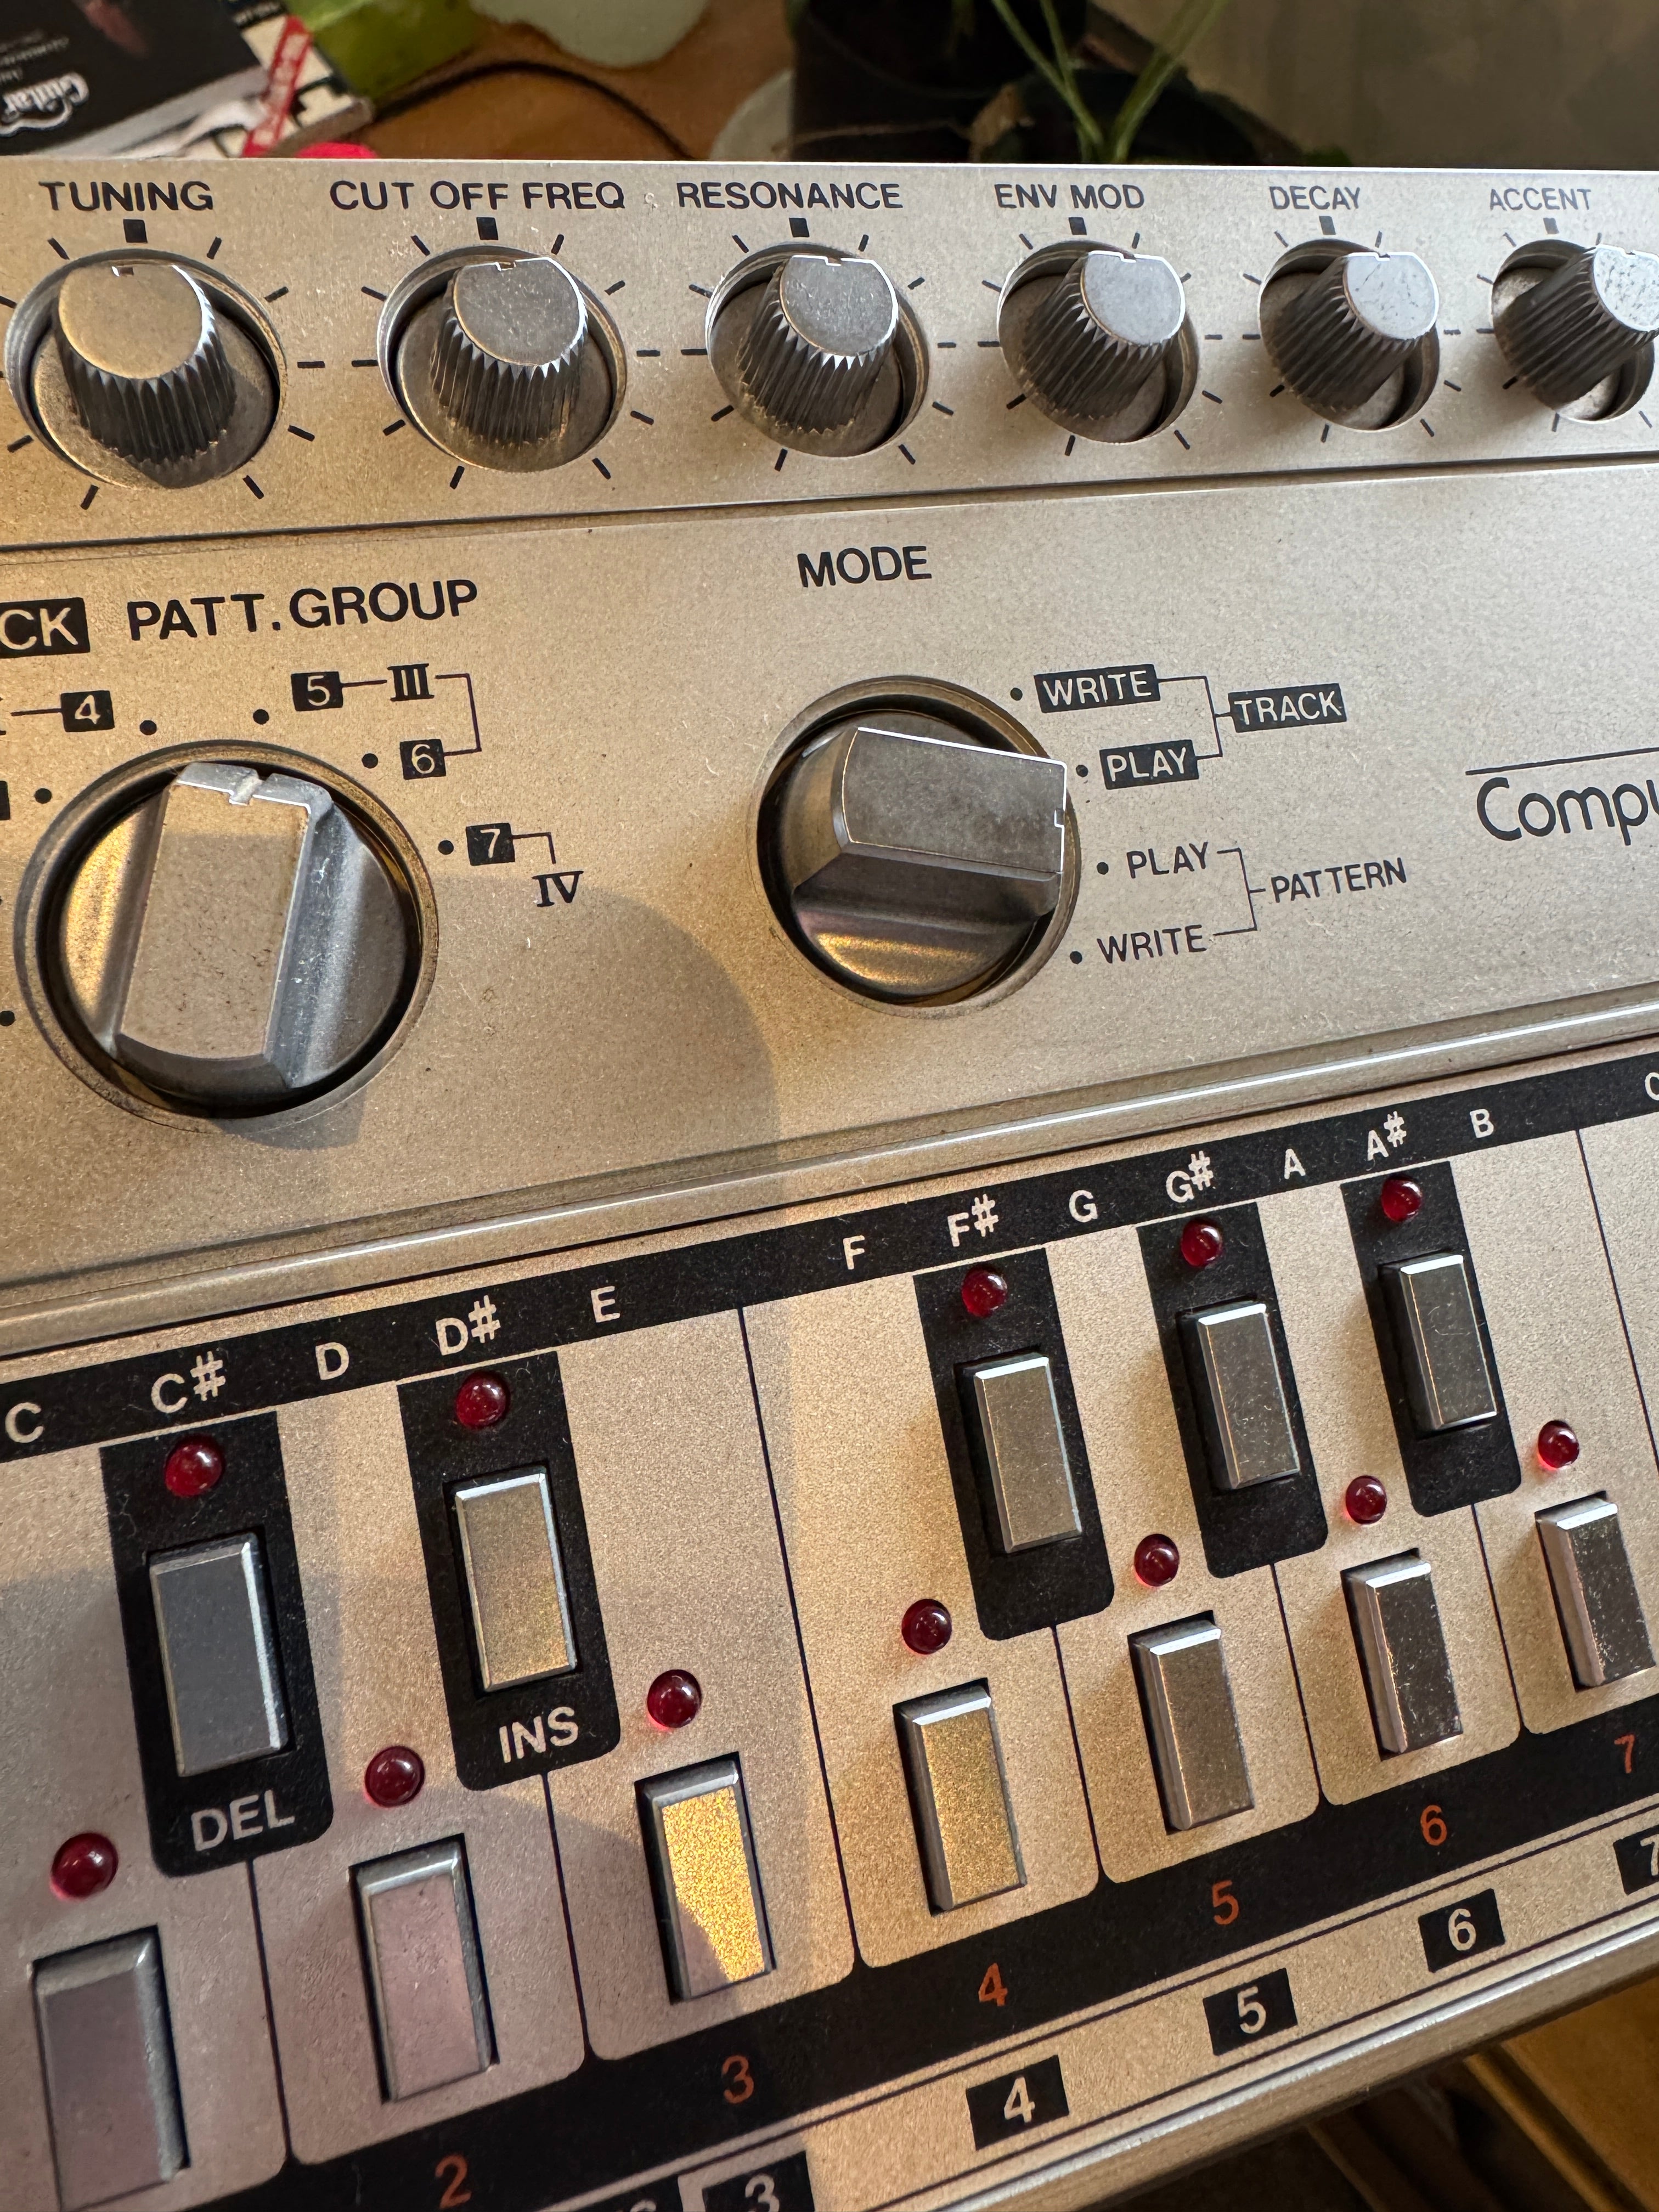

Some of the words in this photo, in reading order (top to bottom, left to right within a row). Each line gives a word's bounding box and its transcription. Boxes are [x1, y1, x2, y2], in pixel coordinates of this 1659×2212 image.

[39, 181, 213, 211] TUNING
[330, 180, 414, 210] CUT
[430, 180, 508, 210] OFF
[523, 181, 625, 209] FREQ
[676, 182, 903, 208] RESONANCE
[996, 184, 1057, 208] ENV
[1069, 184, 1145, 209] MOD
[1269, 186, 1361, 210] DECAY
[1489, 188, 1592, 211] ACCENT
[797, 546, 932, 588] MODE
[307, 676, 330, 707] 5
[386, 663, 434, 702] III
[1041, 670, 1152, 707] WRITE
[75, 694, 100, 724] 4
[1234, 690, 1342, 725] TRACK
[411, 743, 435, 775] 6
[1106, 747, 1188, 782] PLAY
[484, 827, 500, 859] 7
[1127, 842, 1208, 879] PLAY
[532, 871, 584, 908] IV
[1271, 857, 1407, 903] PATTERN
[1097, 924, 1207, 964] WRITE
[5, 1402, 43, 1443] C
[151, 1351, 227, 1413] C#
[314, 1342, 349, 1380] D
[435, 1295, 501, 1356] D#
[590, 1285, 620, 1323] E
[843, 1235, 865, 1270] F
[947, 1193, 999, 1248] F#
[1069, 1189, 1098, 1223] G
[1166, 1150, 1214, 1203] G#
[1284, 1148, 1306, 1180] A
[1367, 1111, 1407, 1161] A#
[1469, 1108, 1494, 1138] B
[499, 1706, 579, 1763] INS
[191, 1790, 296, 1852] DEL
[435, 2153, 472, 2210] 2
[721, 2055, 754, 2104] 3
[978, 1962, 1008, 2007] 4
[1212, 1880, 1239, 1925] 5
[1420, 1805, 1447, 1846] 6
[1615, 1734, 1635, 1774] 7
[745, 2174, 780, 2212] 3
[1003, 2076, 1035, 2123] 4
[1236, 1987, 1267, 2034] 5
[1448, 1908, 1477, 1951] 6
